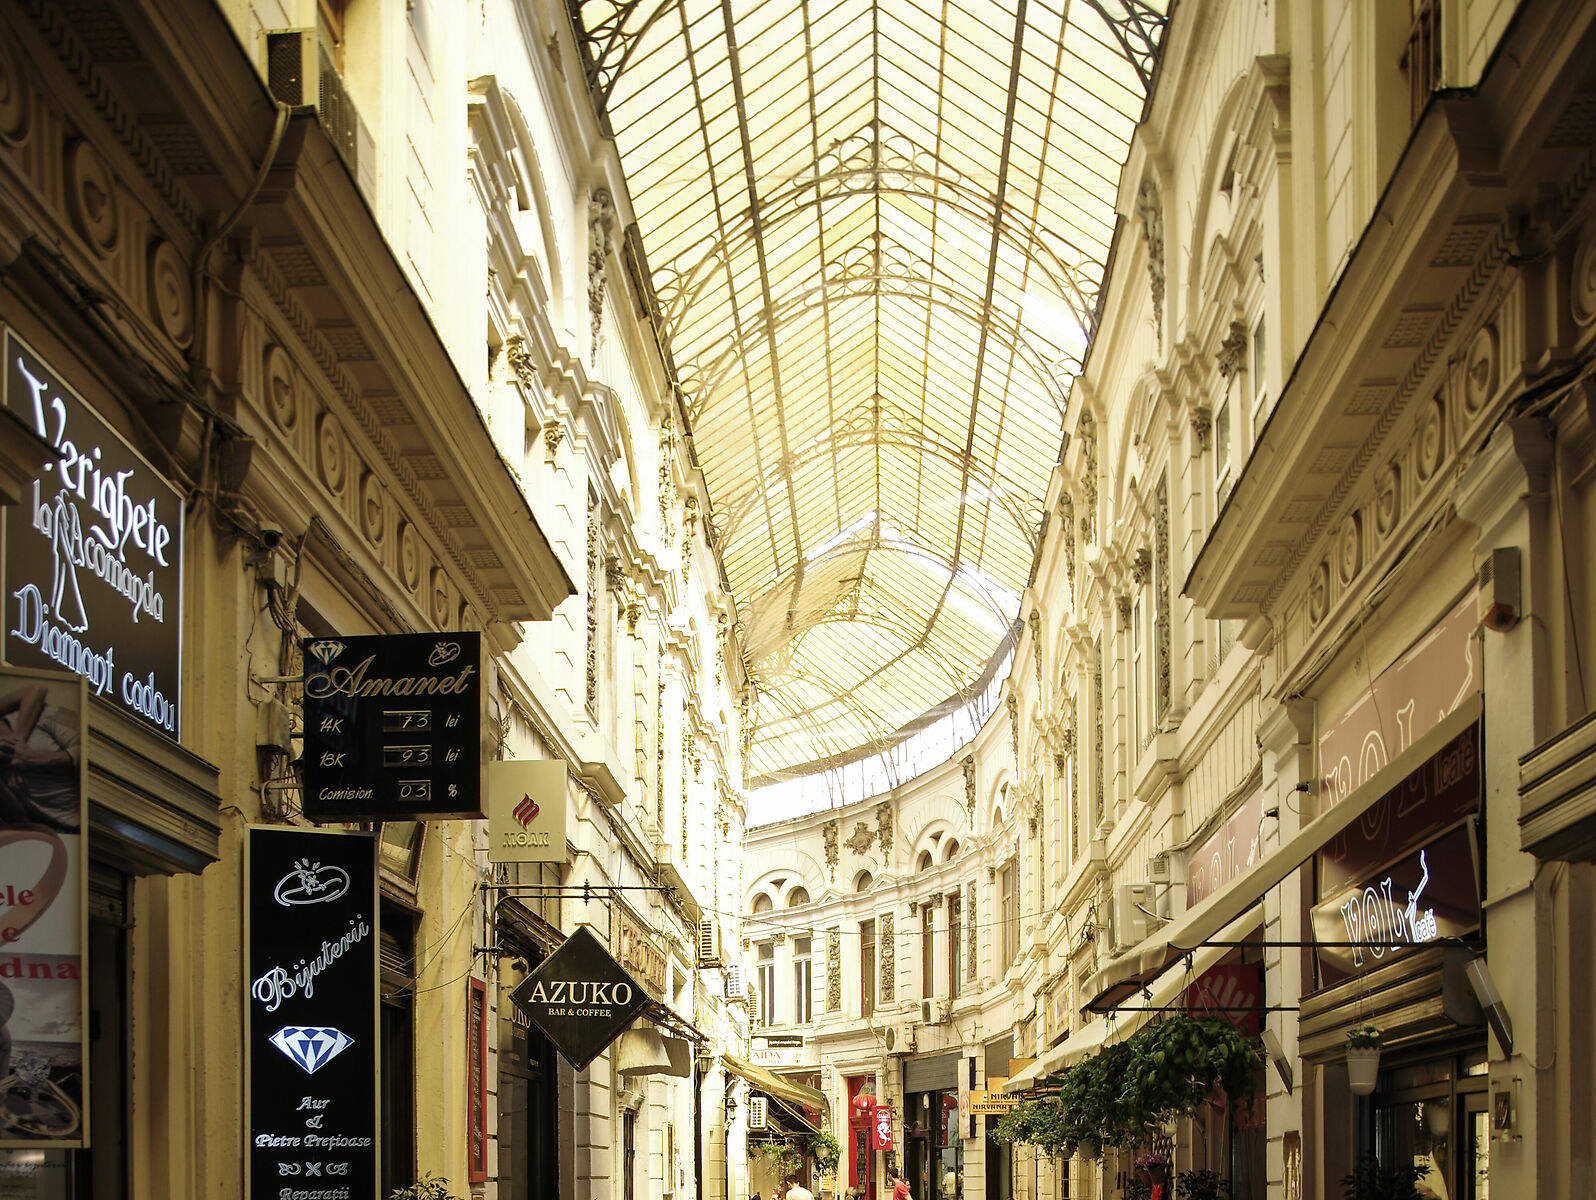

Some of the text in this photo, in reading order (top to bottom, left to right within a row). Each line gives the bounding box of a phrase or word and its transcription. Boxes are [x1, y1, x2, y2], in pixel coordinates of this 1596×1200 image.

[11, 583, 175, 732] Diamant cadou
[305, 654, 476, 699] Amanet
[320, 717, 345, 734] 14K
[445, 714, 461, 728] lei
[320, 751, 347, 768] 18K
[445, 749, 460, 762] lei
[252, 914, 369, 1012] Bijuterii
[528, 981, 632, 1006] AZUKO
[548, 1008, 612, 1018] BAR & COFFEE
[296, 1096, 331, 1111] Aur
[255, 1134, 301, 1148] Pietre
